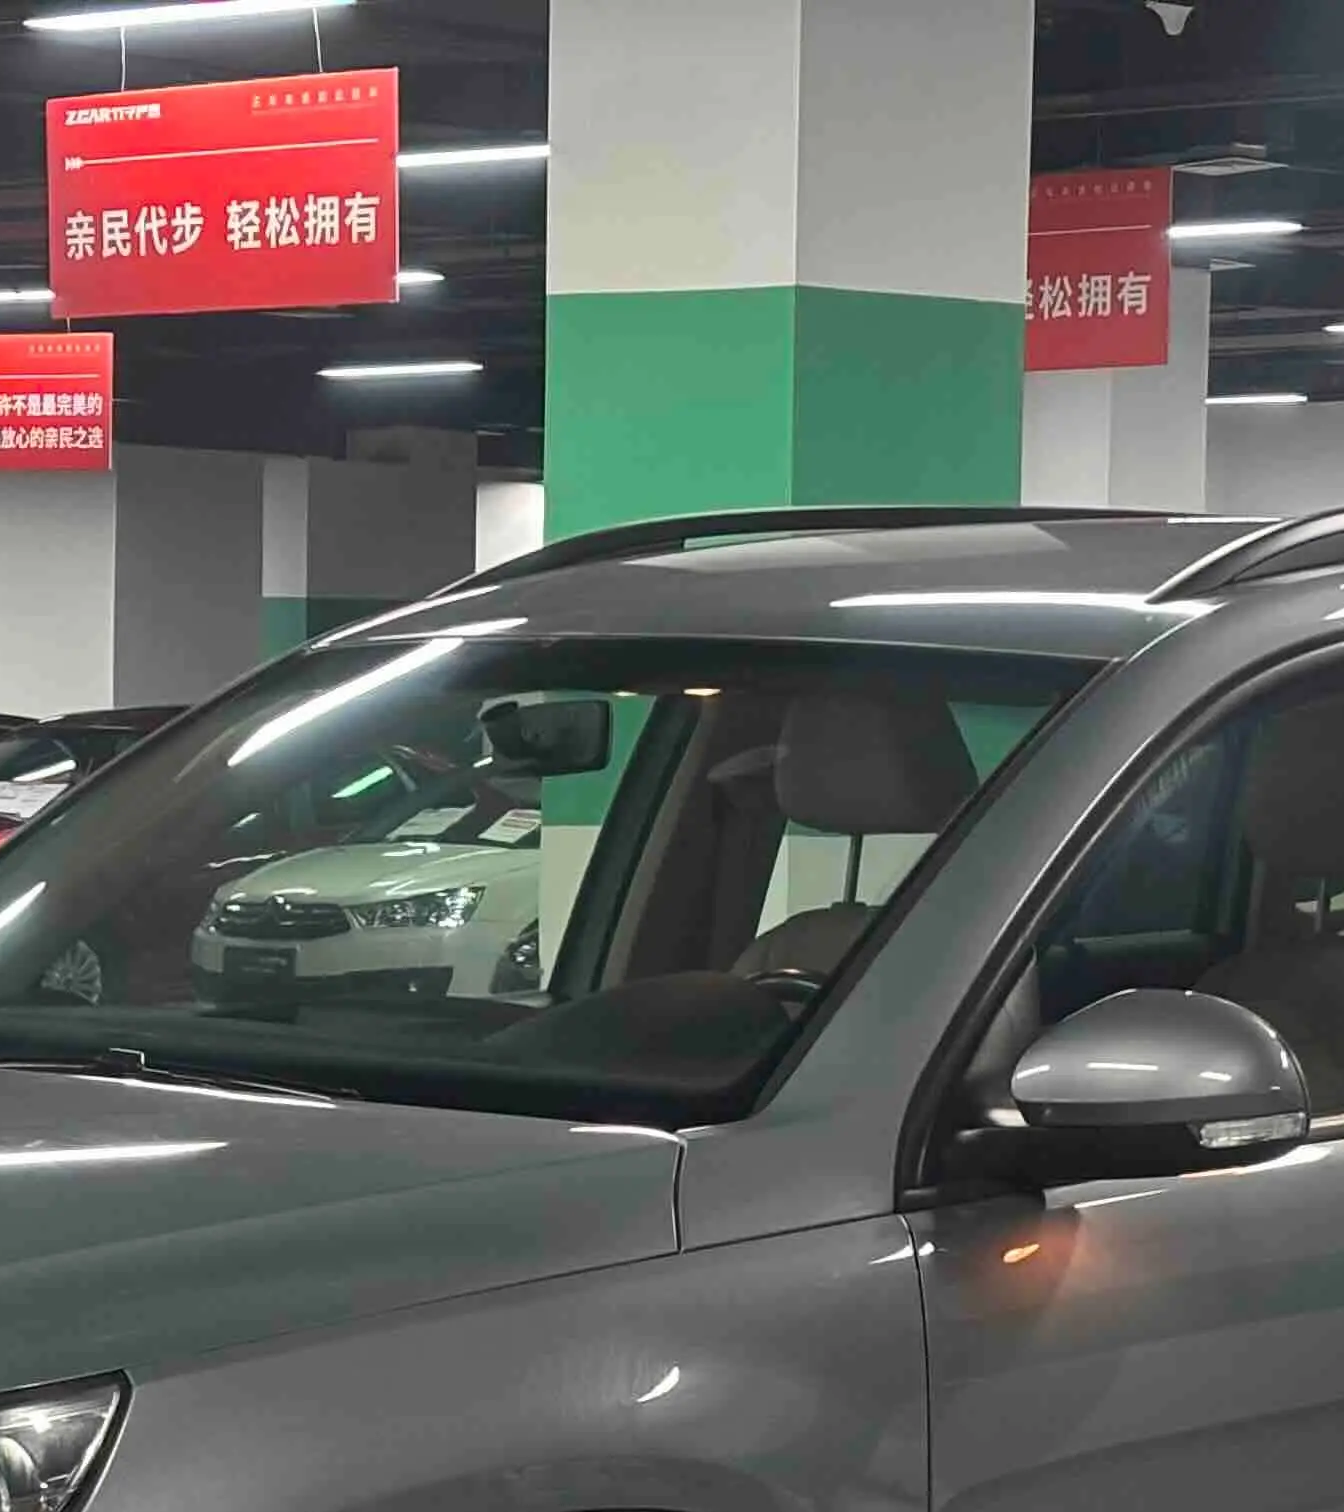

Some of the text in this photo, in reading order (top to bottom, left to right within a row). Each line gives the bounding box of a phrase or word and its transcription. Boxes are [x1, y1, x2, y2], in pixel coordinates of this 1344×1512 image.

[64, 190, 381, 261] 亲民代步 轻松拥有
[1025, 271, 1152, 320] 松拥有
